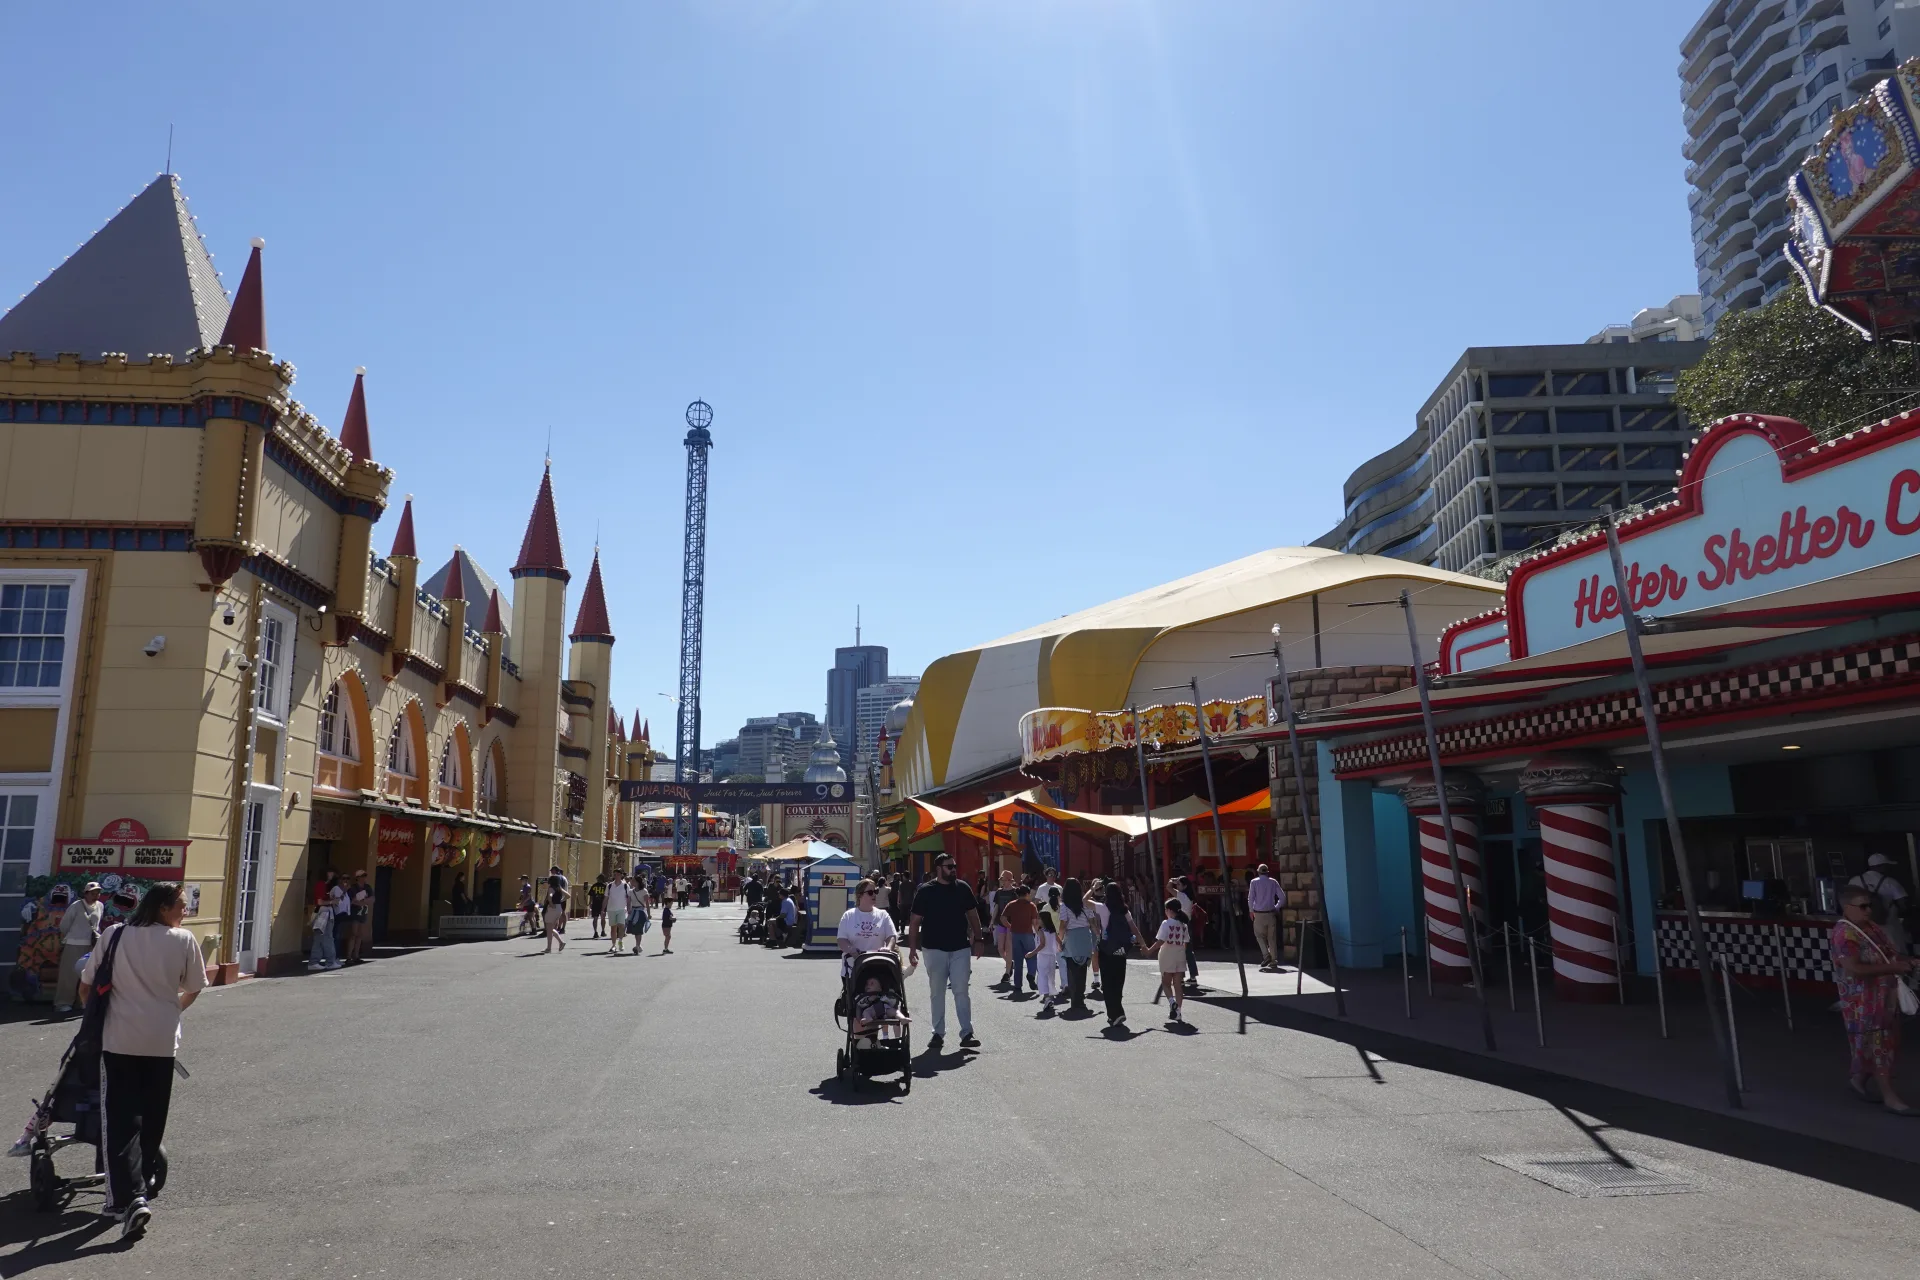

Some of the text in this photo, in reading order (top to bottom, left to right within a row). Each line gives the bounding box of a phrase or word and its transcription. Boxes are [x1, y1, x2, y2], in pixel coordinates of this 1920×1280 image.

[1698, 505, 1874, 590] Skelter
[630, 785, 660, 799] LUNA
[662, 785, 691, 800] PARK
[704, 788, 721, 797] Just
[723, 788, 737, 796] For
[756, 788, 774, 797] Just
[775, 788, 802, 797] Forever
[786, 805, 850, 815] CONEY ISLAND
[67, 847, 114, 856] CANS AND
[134, 848, 174, 856] GENERAL
[71, 856, 108, 864] BOTTLES
[135, 856, 172, 864] RUBBISH
